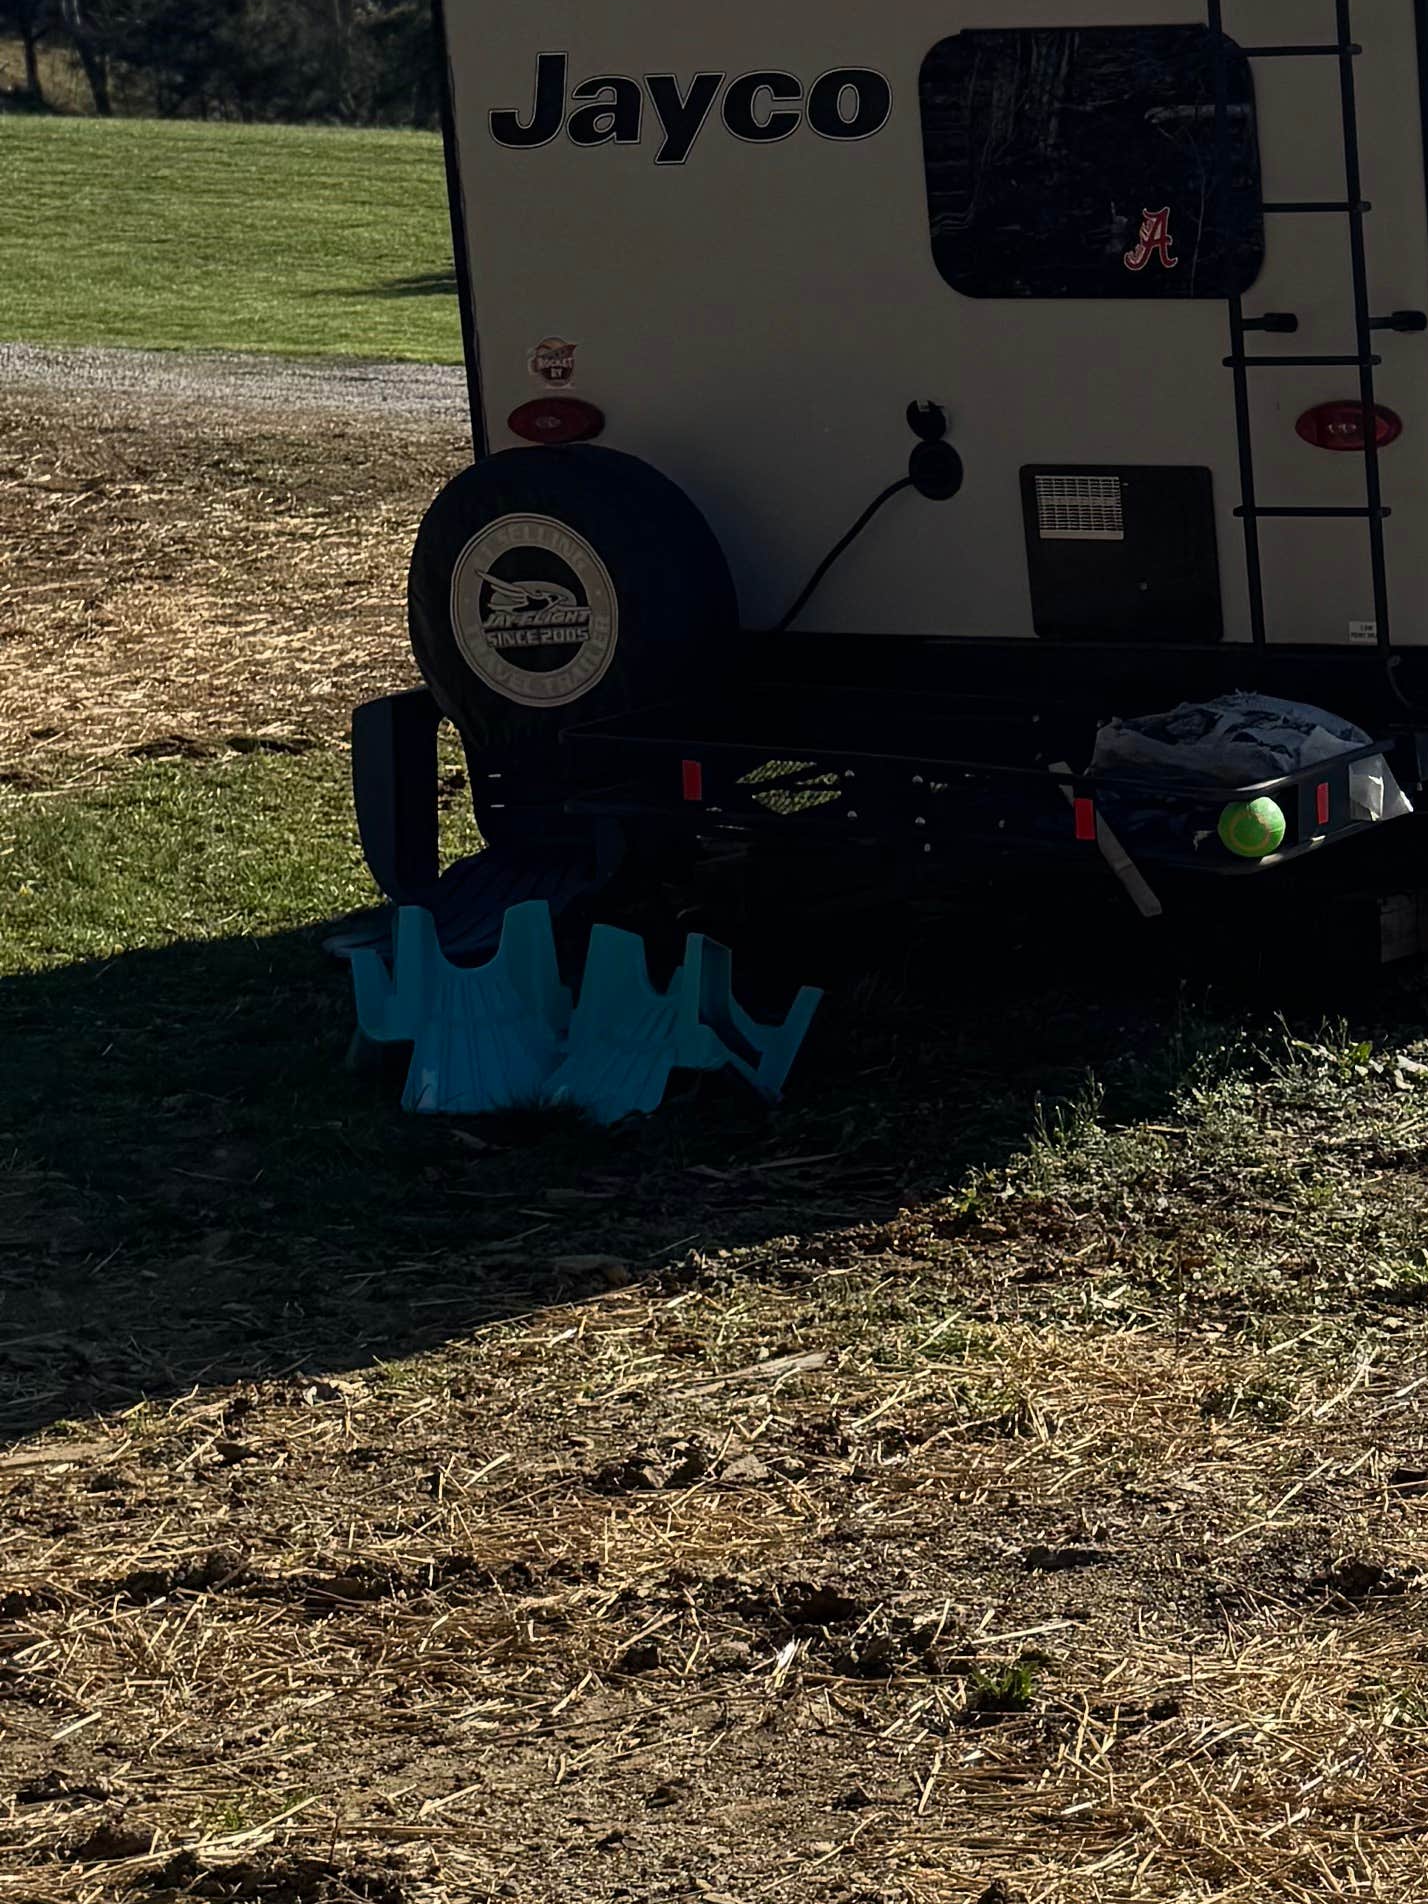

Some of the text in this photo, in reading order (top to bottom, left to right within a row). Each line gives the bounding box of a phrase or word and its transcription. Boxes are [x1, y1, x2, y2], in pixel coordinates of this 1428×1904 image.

[488, 51, 893, 165] Jayco
[1124, 206, 1178, 271] A
[487, 627, 590, 646] SINCE 2005
